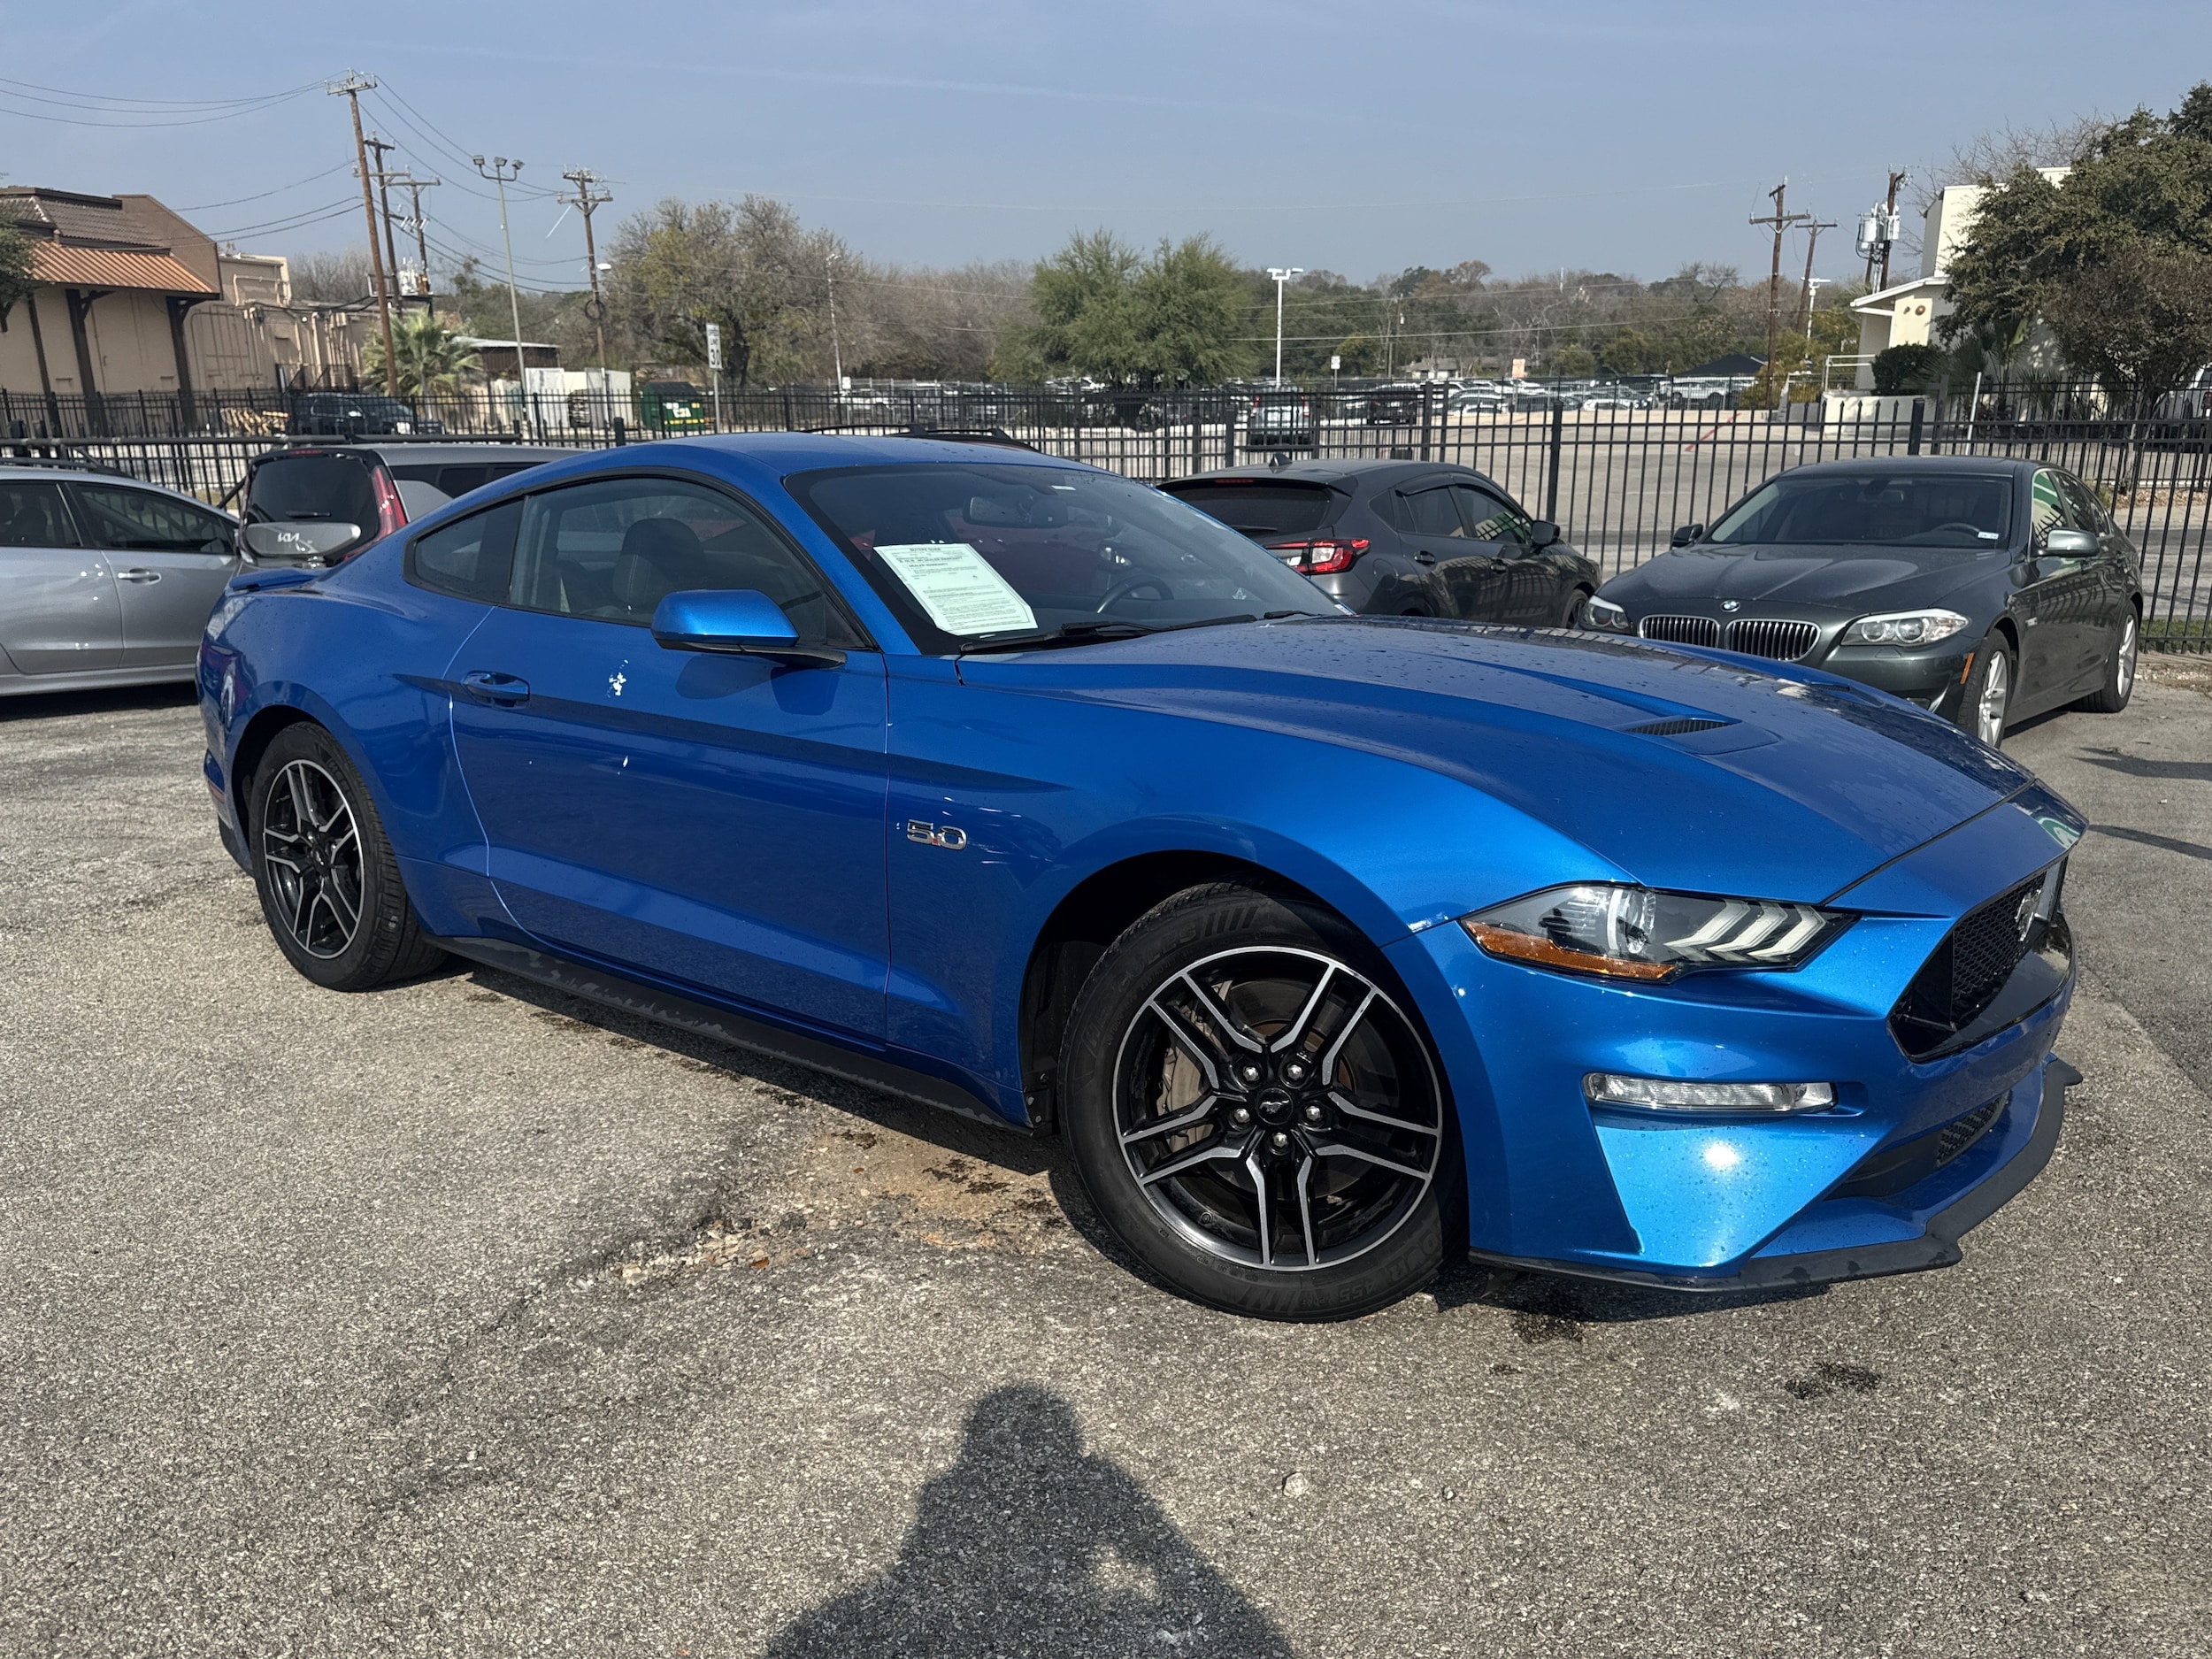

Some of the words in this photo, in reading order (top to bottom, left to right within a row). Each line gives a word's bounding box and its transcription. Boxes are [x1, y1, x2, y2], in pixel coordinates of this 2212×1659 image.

[710, 349, 721, 365] 30
[277, 533, 300, 542] KIA
[907, 818, 967, 850] 5.0
